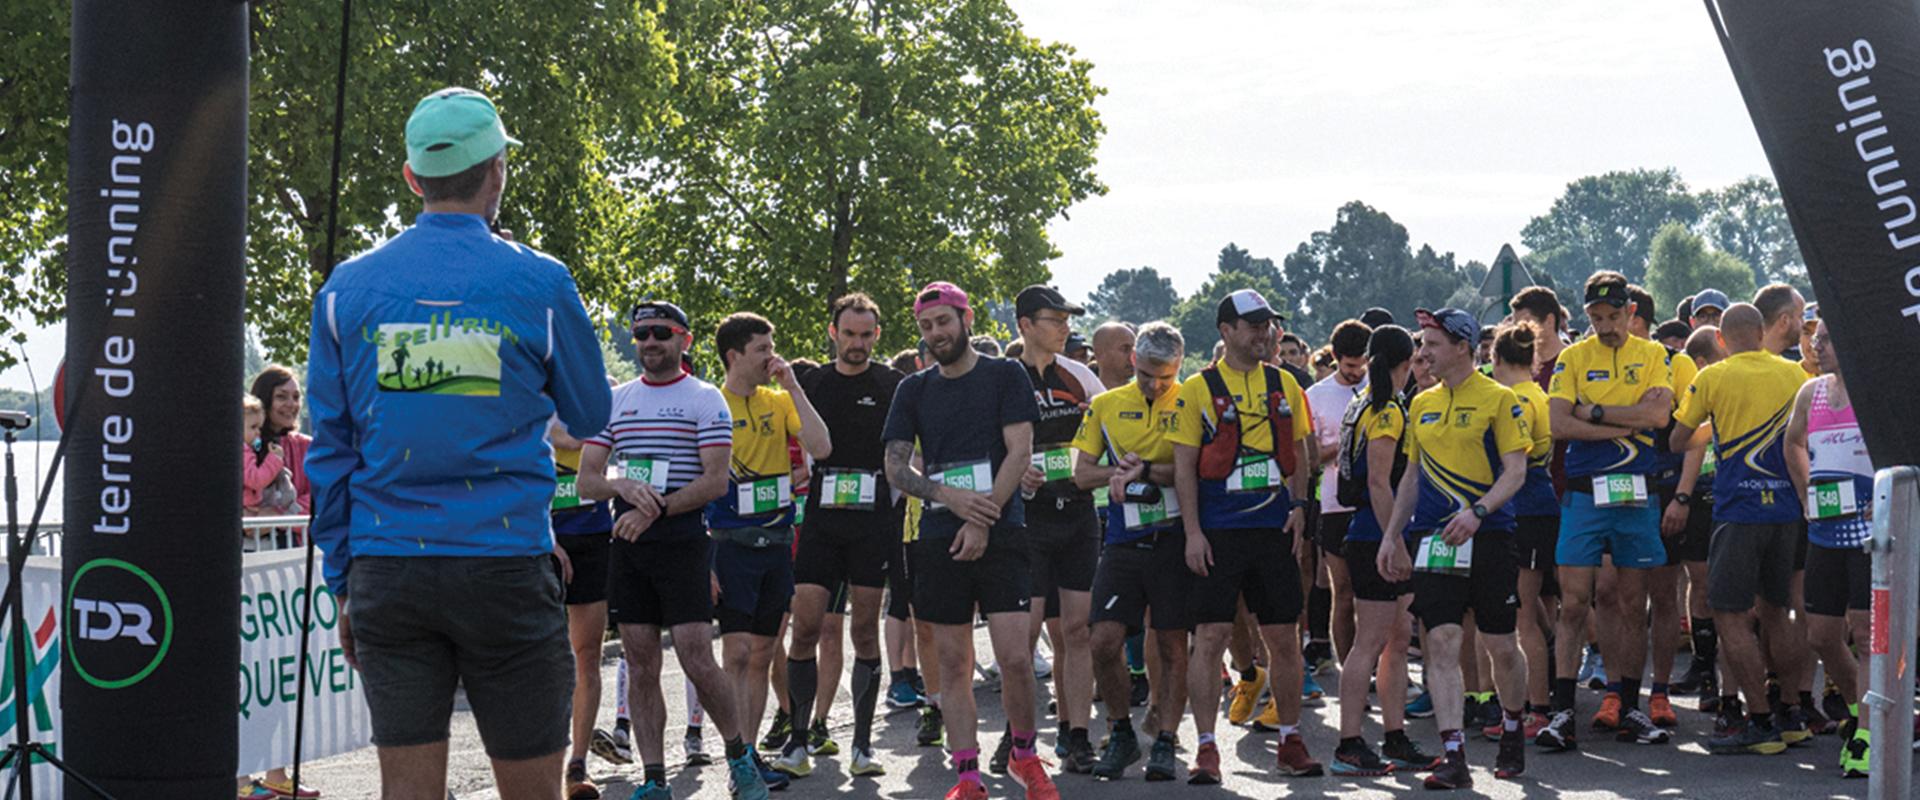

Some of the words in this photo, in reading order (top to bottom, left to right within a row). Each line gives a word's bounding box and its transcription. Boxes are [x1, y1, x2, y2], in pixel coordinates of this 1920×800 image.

[1824, 38, 1920, 251] running
[100, 118, 156, 318] running
[361, 325, 387, 347] LE
[94, 336, 137, 397] de
[93, 413, 135, 536] terre
[1243, 462, 1268, 478] 1609
[1609, 478, 1632, 493] 1555
[756, 486, 776, 501] 1515
[837, 480, 858, 495] 1512
[72, 599, 157, 646] TDR
